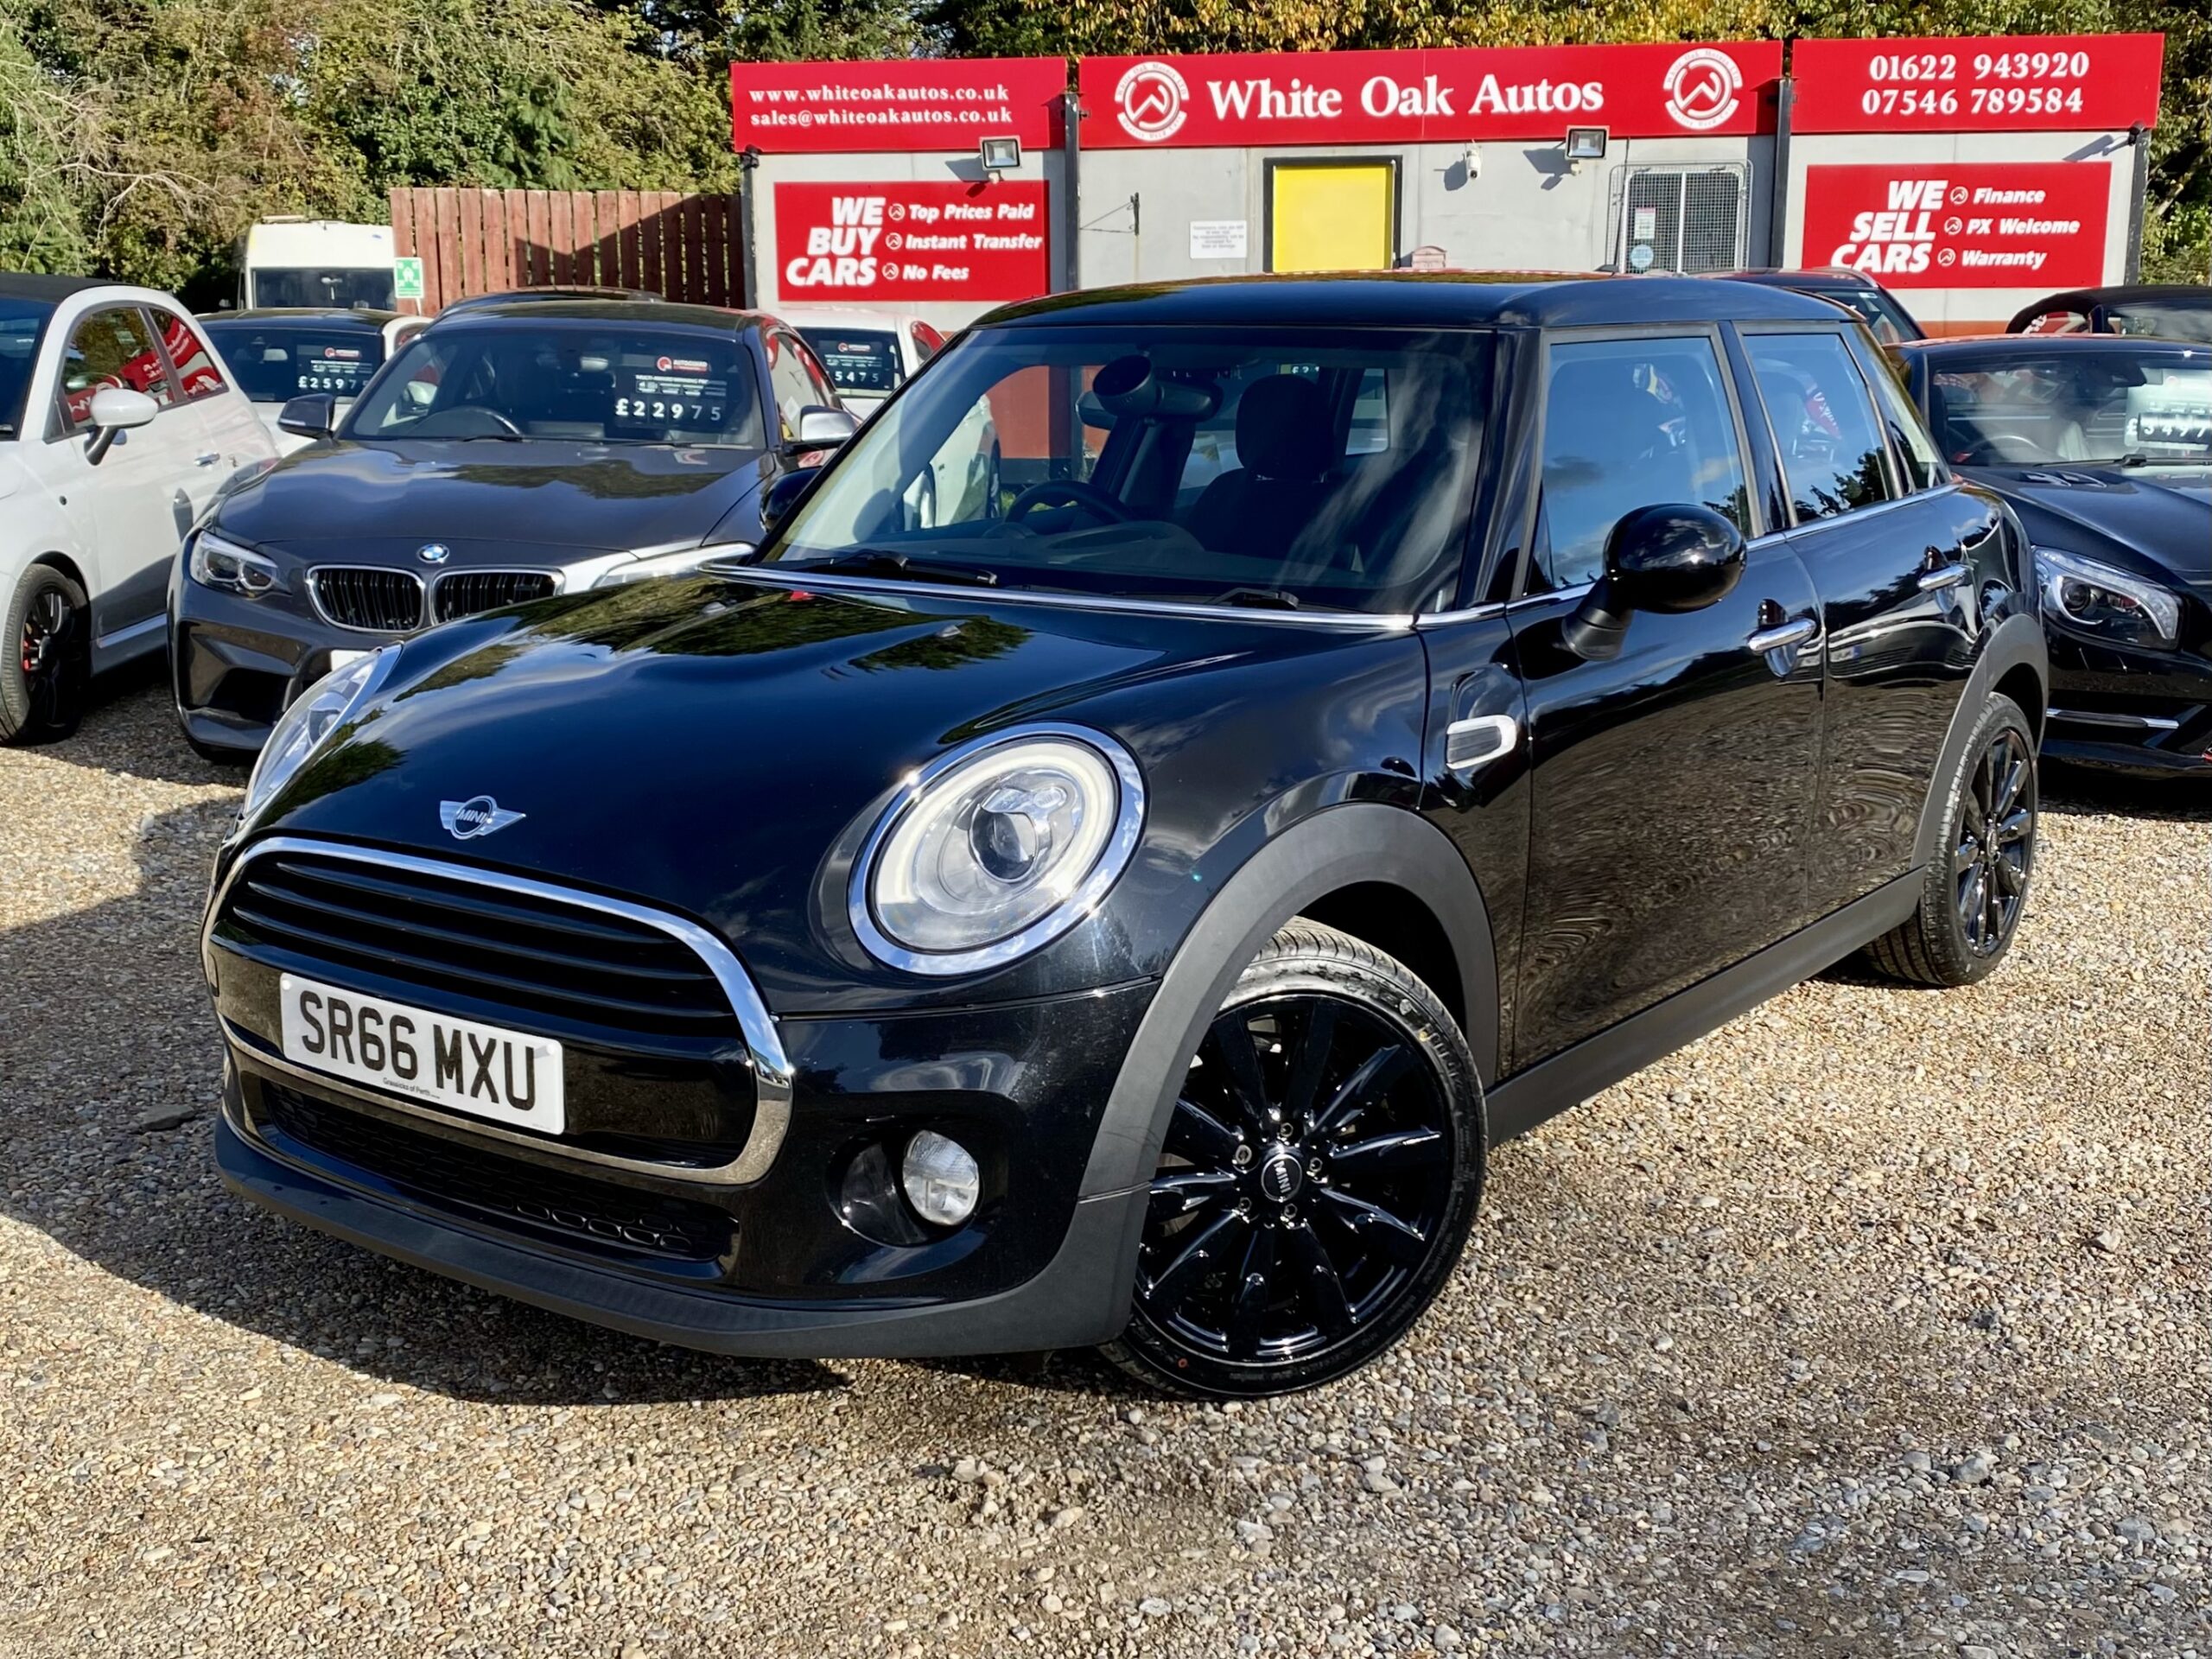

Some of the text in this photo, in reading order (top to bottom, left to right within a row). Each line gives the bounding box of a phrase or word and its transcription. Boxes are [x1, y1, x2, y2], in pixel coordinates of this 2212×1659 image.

[1870, 52, 2088, 80] 01622 943920
[750, 84, 1008, 101] www.whiteoakautos.co.uk
[1207, 74, 1604, 119] White Oak Autos
[1862, 88, 2082, 115] 07546 789584
[751, 107, 1012, 126] sales@whiteoakautos.co.uk
[1888, 181, 1948, 210] WE
[1974, 188, 2045, 203] Finance
[833, 197, 886, 225] WE
[909, 204, 1034, 223] Top Prices Paid
[1848, 213, 1936, 242] SELL
[1967, 219, 2080, 234] PX Welcome
[807, 227, 881, 256] BUY
[906, 233, 1042, 249] Instant Transfer
[786, 257, 876, 286] CARS
[1830, 244, 1932, 273] CARS
[1962, 251, 2046, 270] Warranty
[903, 265, 969, 280] No Fees
[615, 397, 722, 422] £22975
[456, 809, 488, 823] MINI
[300, 990, 537, 1111] SR66 MXU
[1273, 1160, 1293, 1194] MINI
